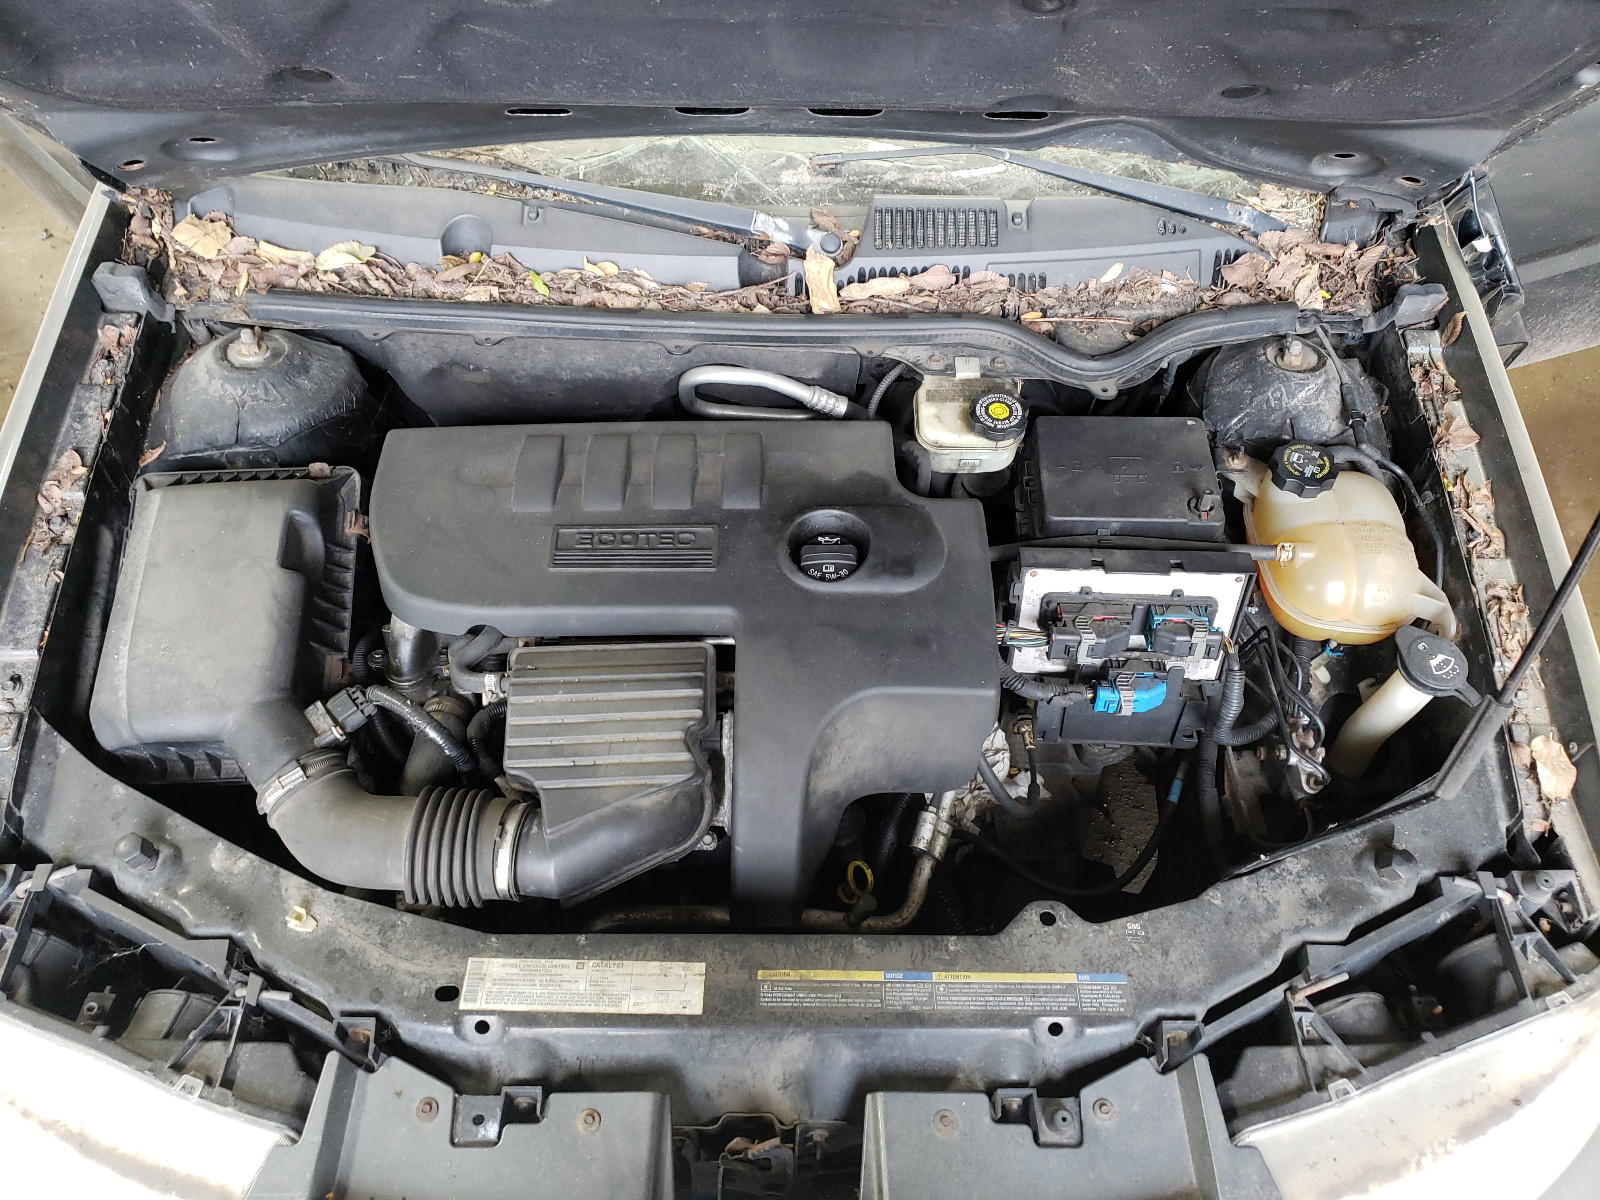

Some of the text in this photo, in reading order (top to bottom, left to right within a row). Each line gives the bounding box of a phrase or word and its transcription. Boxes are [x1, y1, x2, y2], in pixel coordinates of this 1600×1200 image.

[574, 531, 697, 548] ECOTEC
[807, 568, 849, 580] SAE 5W-30
[591, 961, 625, 969] CATALYST
